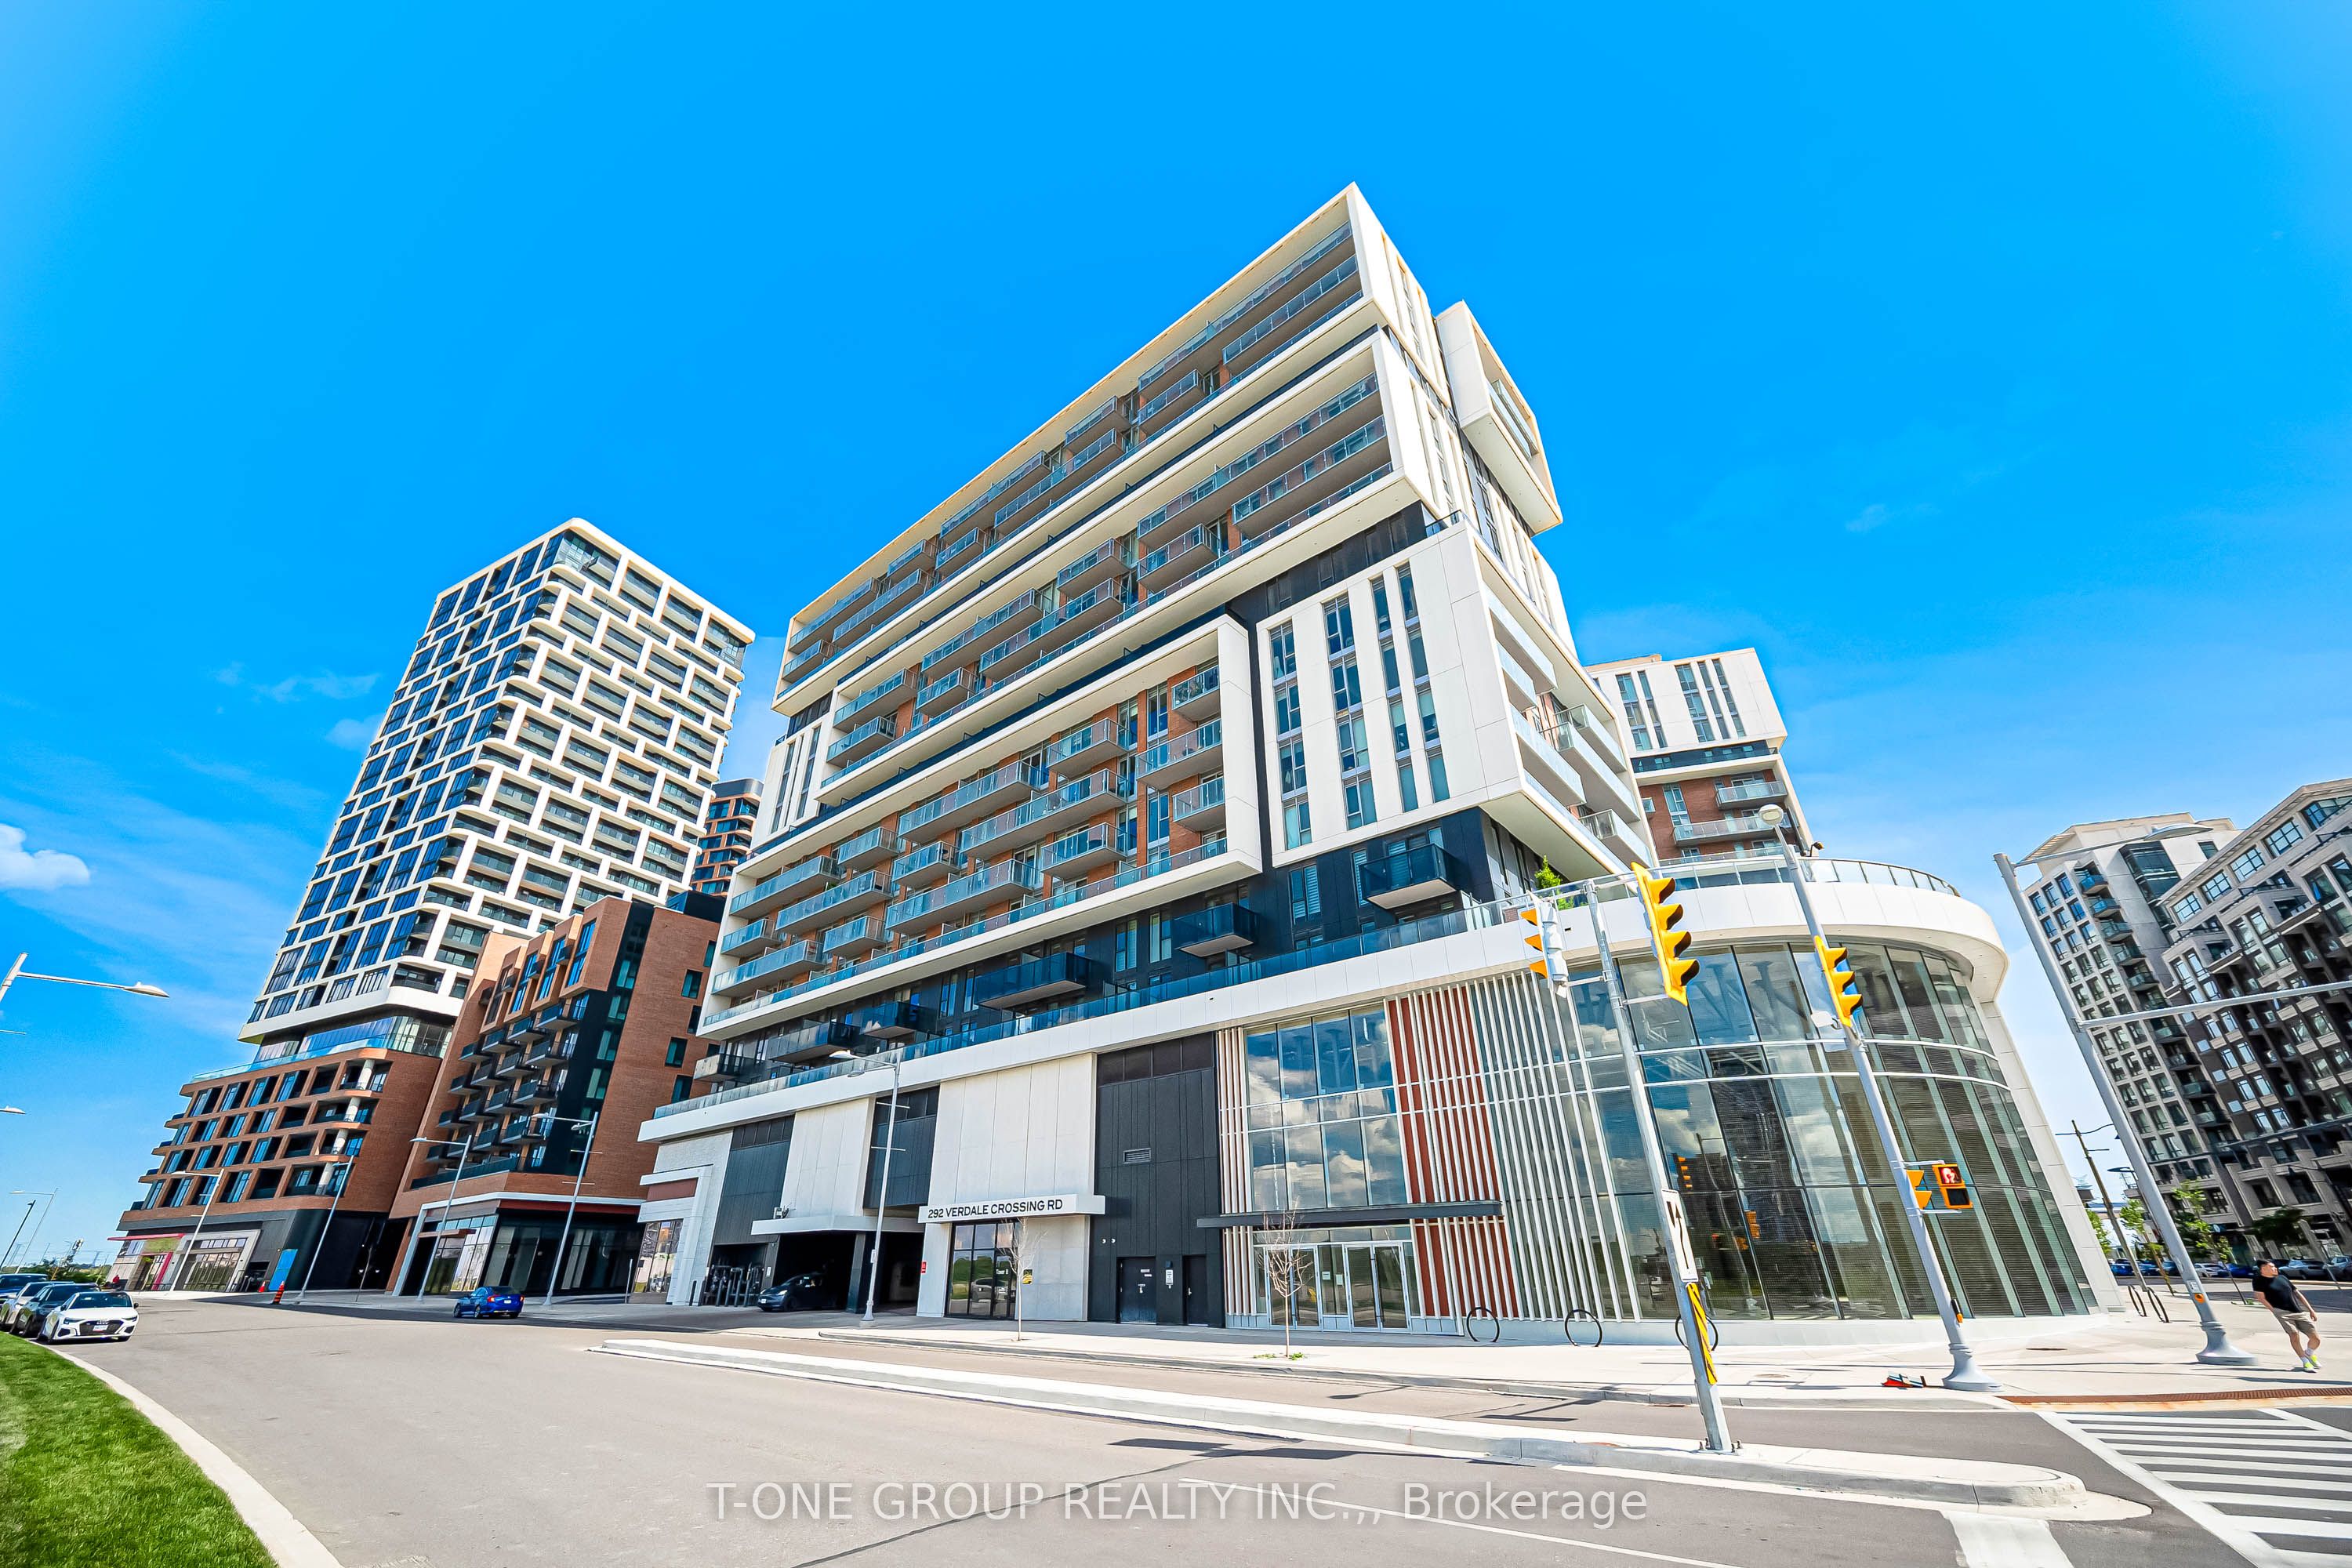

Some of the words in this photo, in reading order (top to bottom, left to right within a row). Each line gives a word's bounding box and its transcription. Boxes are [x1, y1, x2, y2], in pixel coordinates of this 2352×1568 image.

[928, 1208, 944, 1218] 292
[946, 1204, 989, 1217] VERDALE
[991, 1200, 1044, 1214] CROSSING
[1047, 1199, 1063, 1210] RD
